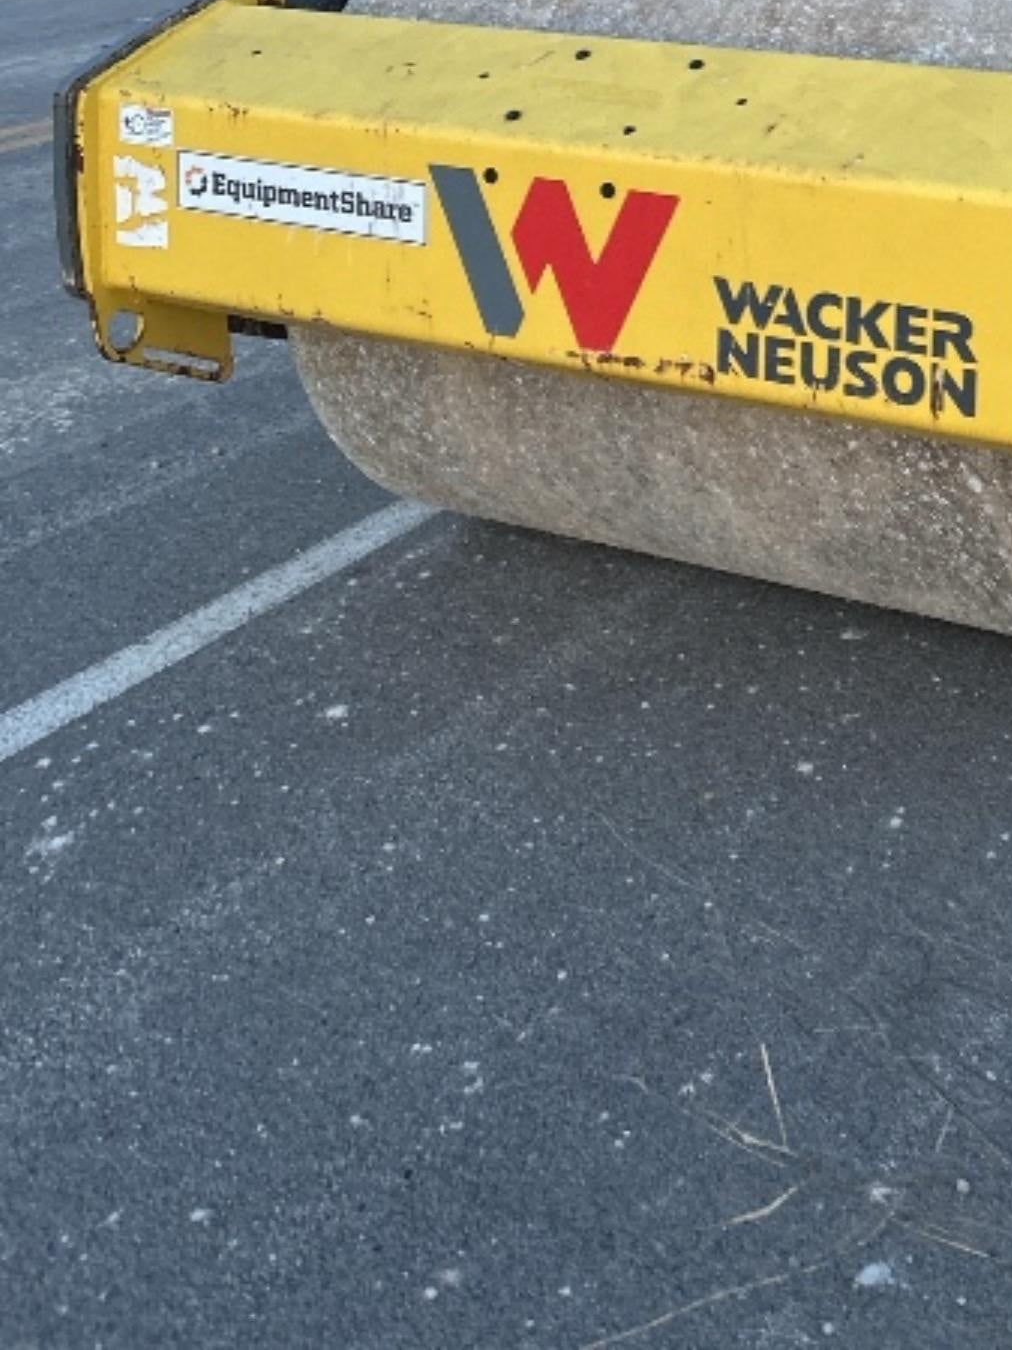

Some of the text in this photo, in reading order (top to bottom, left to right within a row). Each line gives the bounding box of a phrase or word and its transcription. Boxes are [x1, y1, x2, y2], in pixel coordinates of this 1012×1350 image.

[212, 170, 412, 223] EquipmentShare
[713, 275, 978, 363] WACKER
[717, 327, 977, 418] NEUSON
